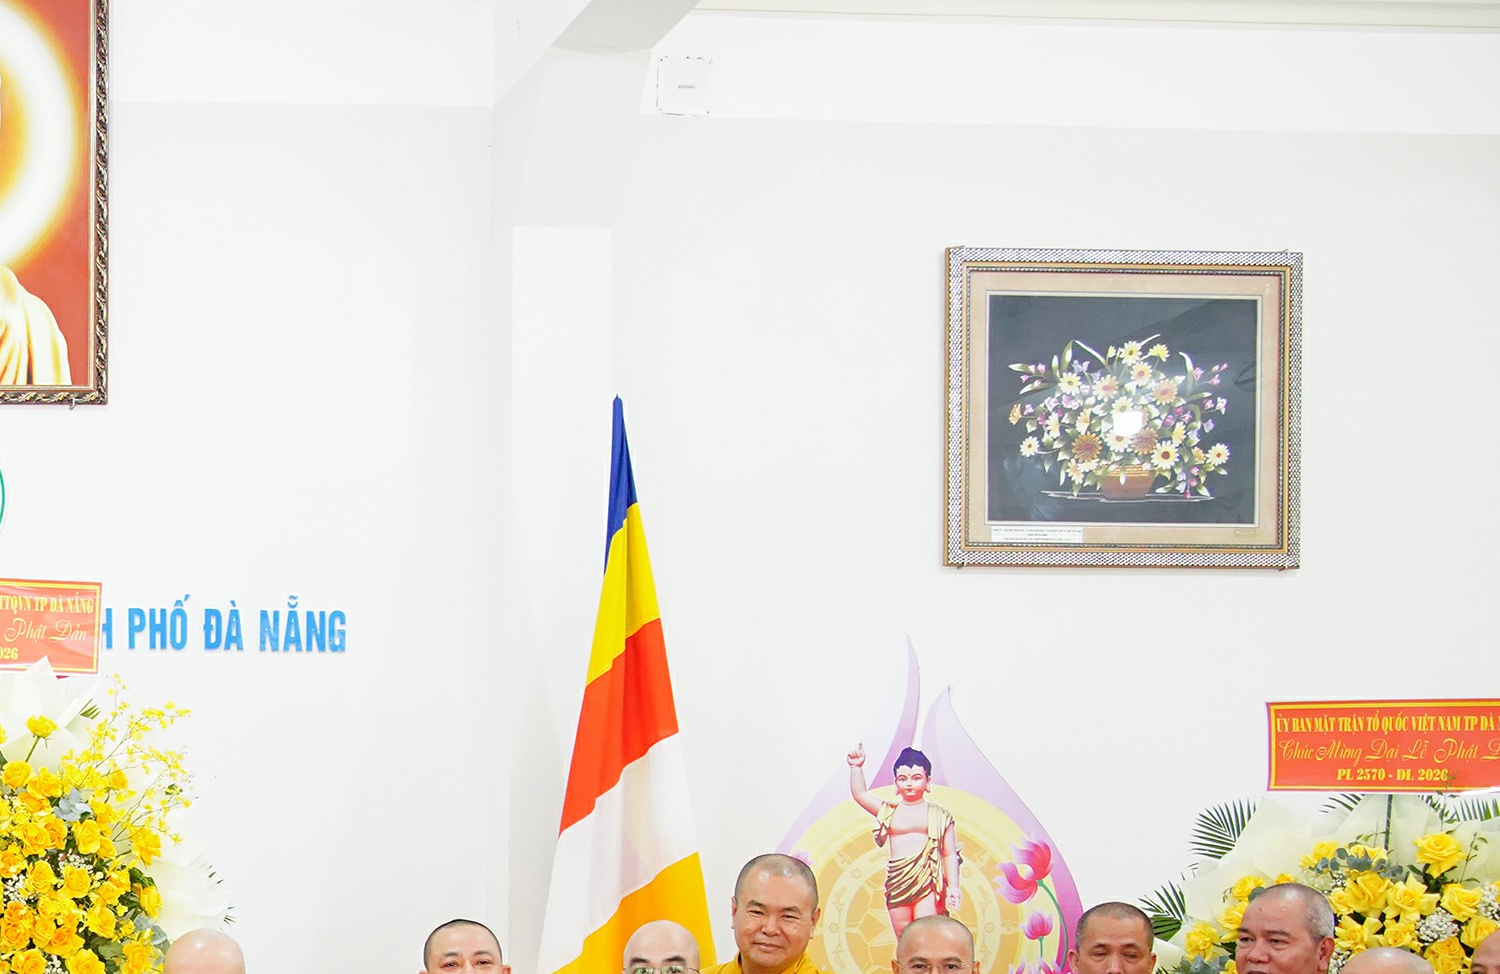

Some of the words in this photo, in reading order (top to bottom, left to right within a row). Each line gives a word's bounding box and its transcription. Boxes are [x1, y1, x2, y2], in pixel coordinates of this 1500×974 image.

[34, 596, 48, 612] TP
[3, 617, 47, 643] Phật
[49, 619, 88, 644] Đản
[128, 594, 191, 651] PHỐ
[203, 600, 244, 651] ĐÀ
[259, 595, 347, 652] NẴNG
[1292, 717, 1312, 733] BAN
[1338, 713, 1364, 736] TRẬN
[1367, 710, 1380, 732] TỔ
[1381, 711, 1409, 736] QUỐC
[1411, 713, 1436, 734] VIỆT
[1438, 715, 1461, 732] NAM
[1463, 715, 1479, 731] TP
[1279, 739, 1314, 761] Chúc
[1316, 739, 1362, 768] Mừng
[1402, 738, 1429, 762] Lễ
[1433, 738, 1479, 764] Phật
[1337, 768, 1354, 781] PL
[1357, 768, 1386, 782] 2570
[1417, 768, 1449, 782] 2026
